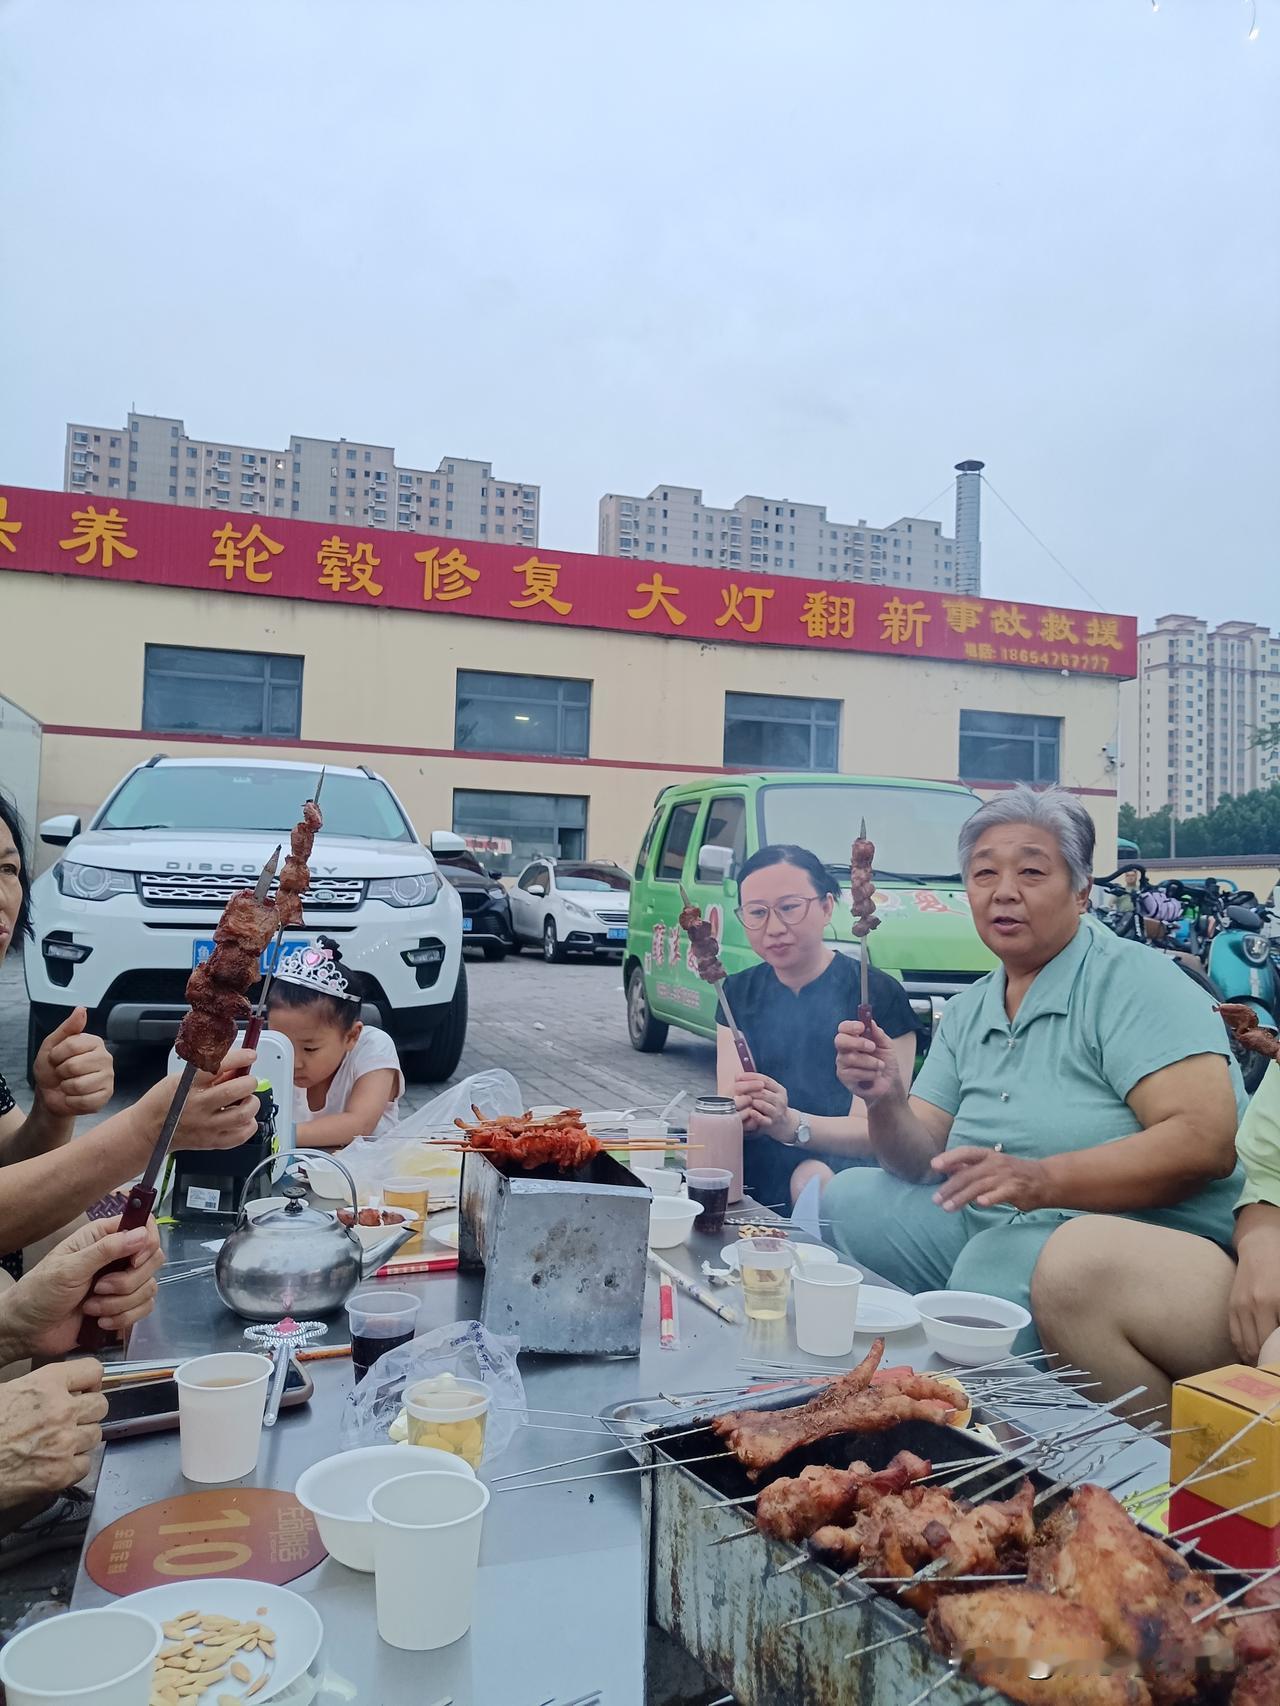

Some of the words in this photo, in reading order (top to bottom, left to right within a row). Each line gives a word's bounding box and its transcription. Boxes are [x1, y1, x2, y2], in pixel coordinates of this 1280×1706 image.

[627, 572, 932, 647] 大灯翻新
[943, 599, 1123, 650] 事故救援
[152, 1509, 253, 1576] 10
